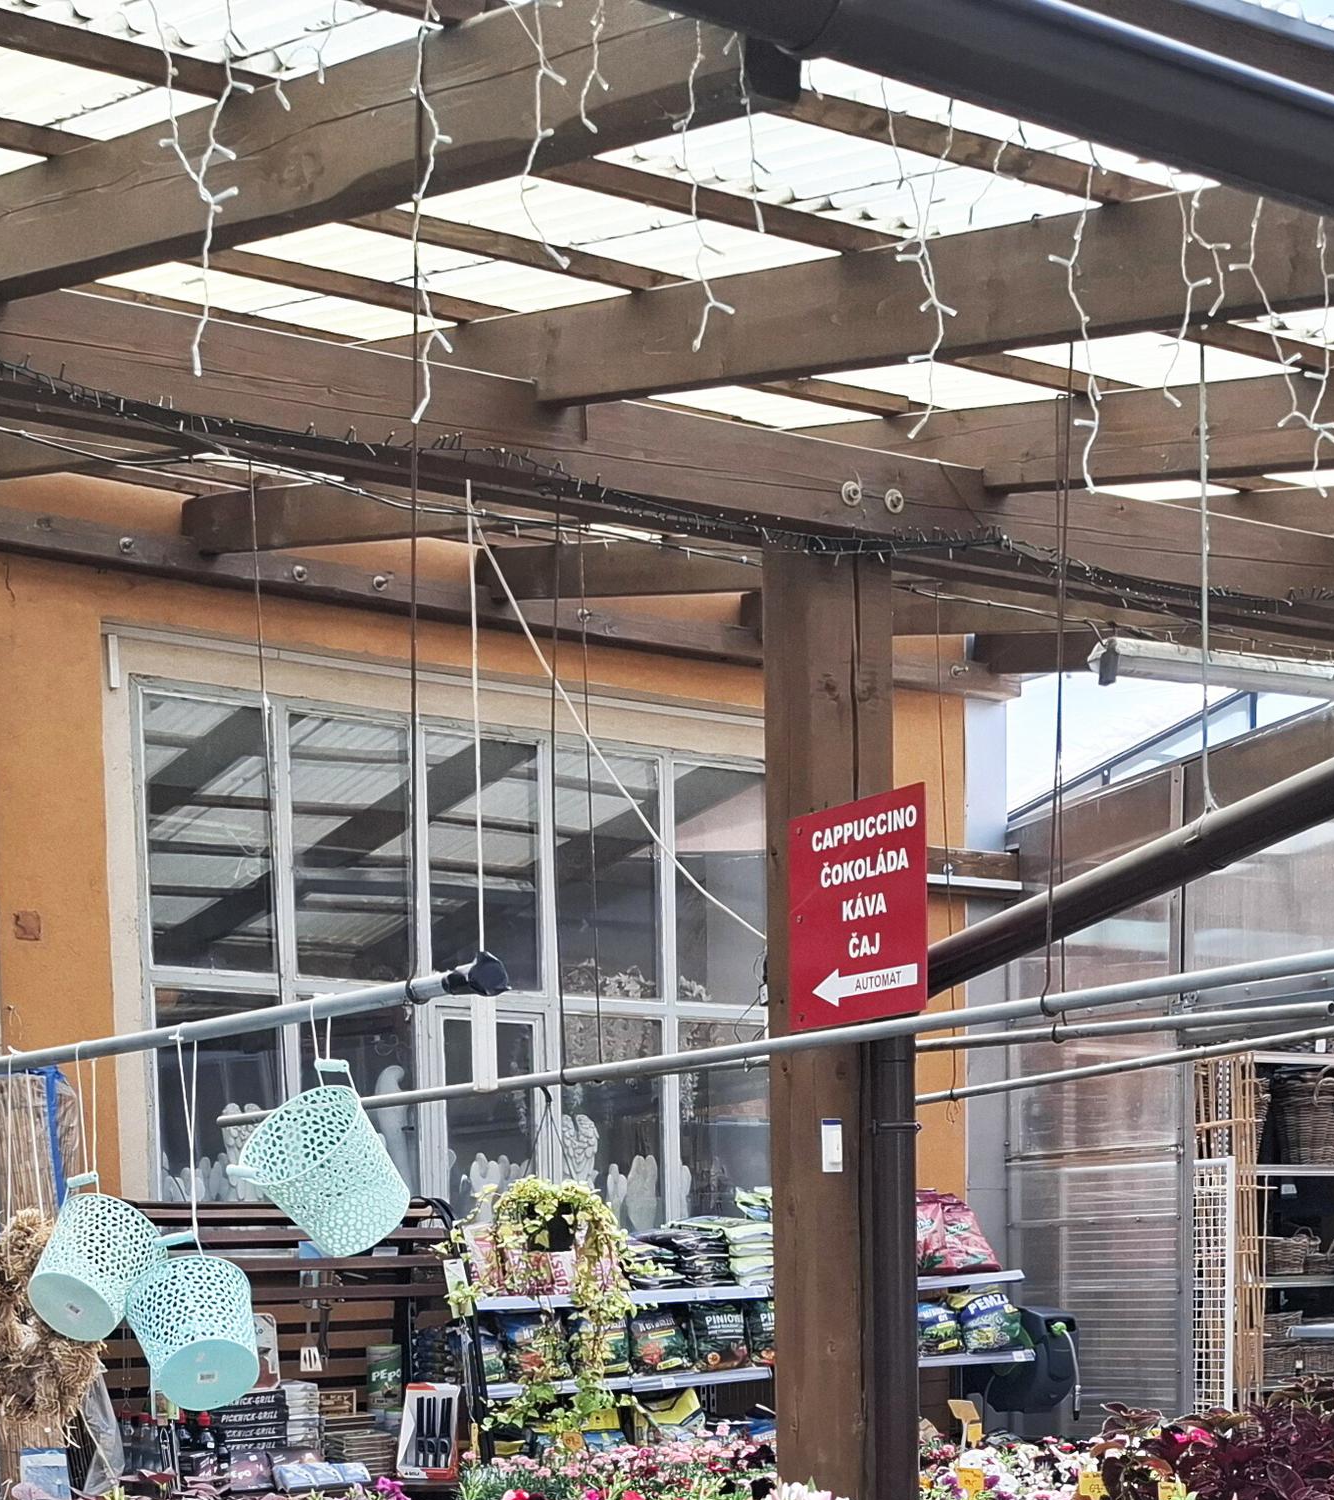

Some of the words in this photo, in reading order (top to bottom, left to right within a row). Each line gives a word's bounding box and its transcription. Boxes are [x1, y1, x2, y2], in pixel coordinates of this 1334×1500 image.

[811, 804, 917, 852] CAPPUCCINO
[820, 848, 909, 888] ČOKOLÁDA
[841, 892, 887, 922] KÁVA
[848, 932, 881, 959] ČAJ
[854, 970, 903, 992] AUTOMAT
